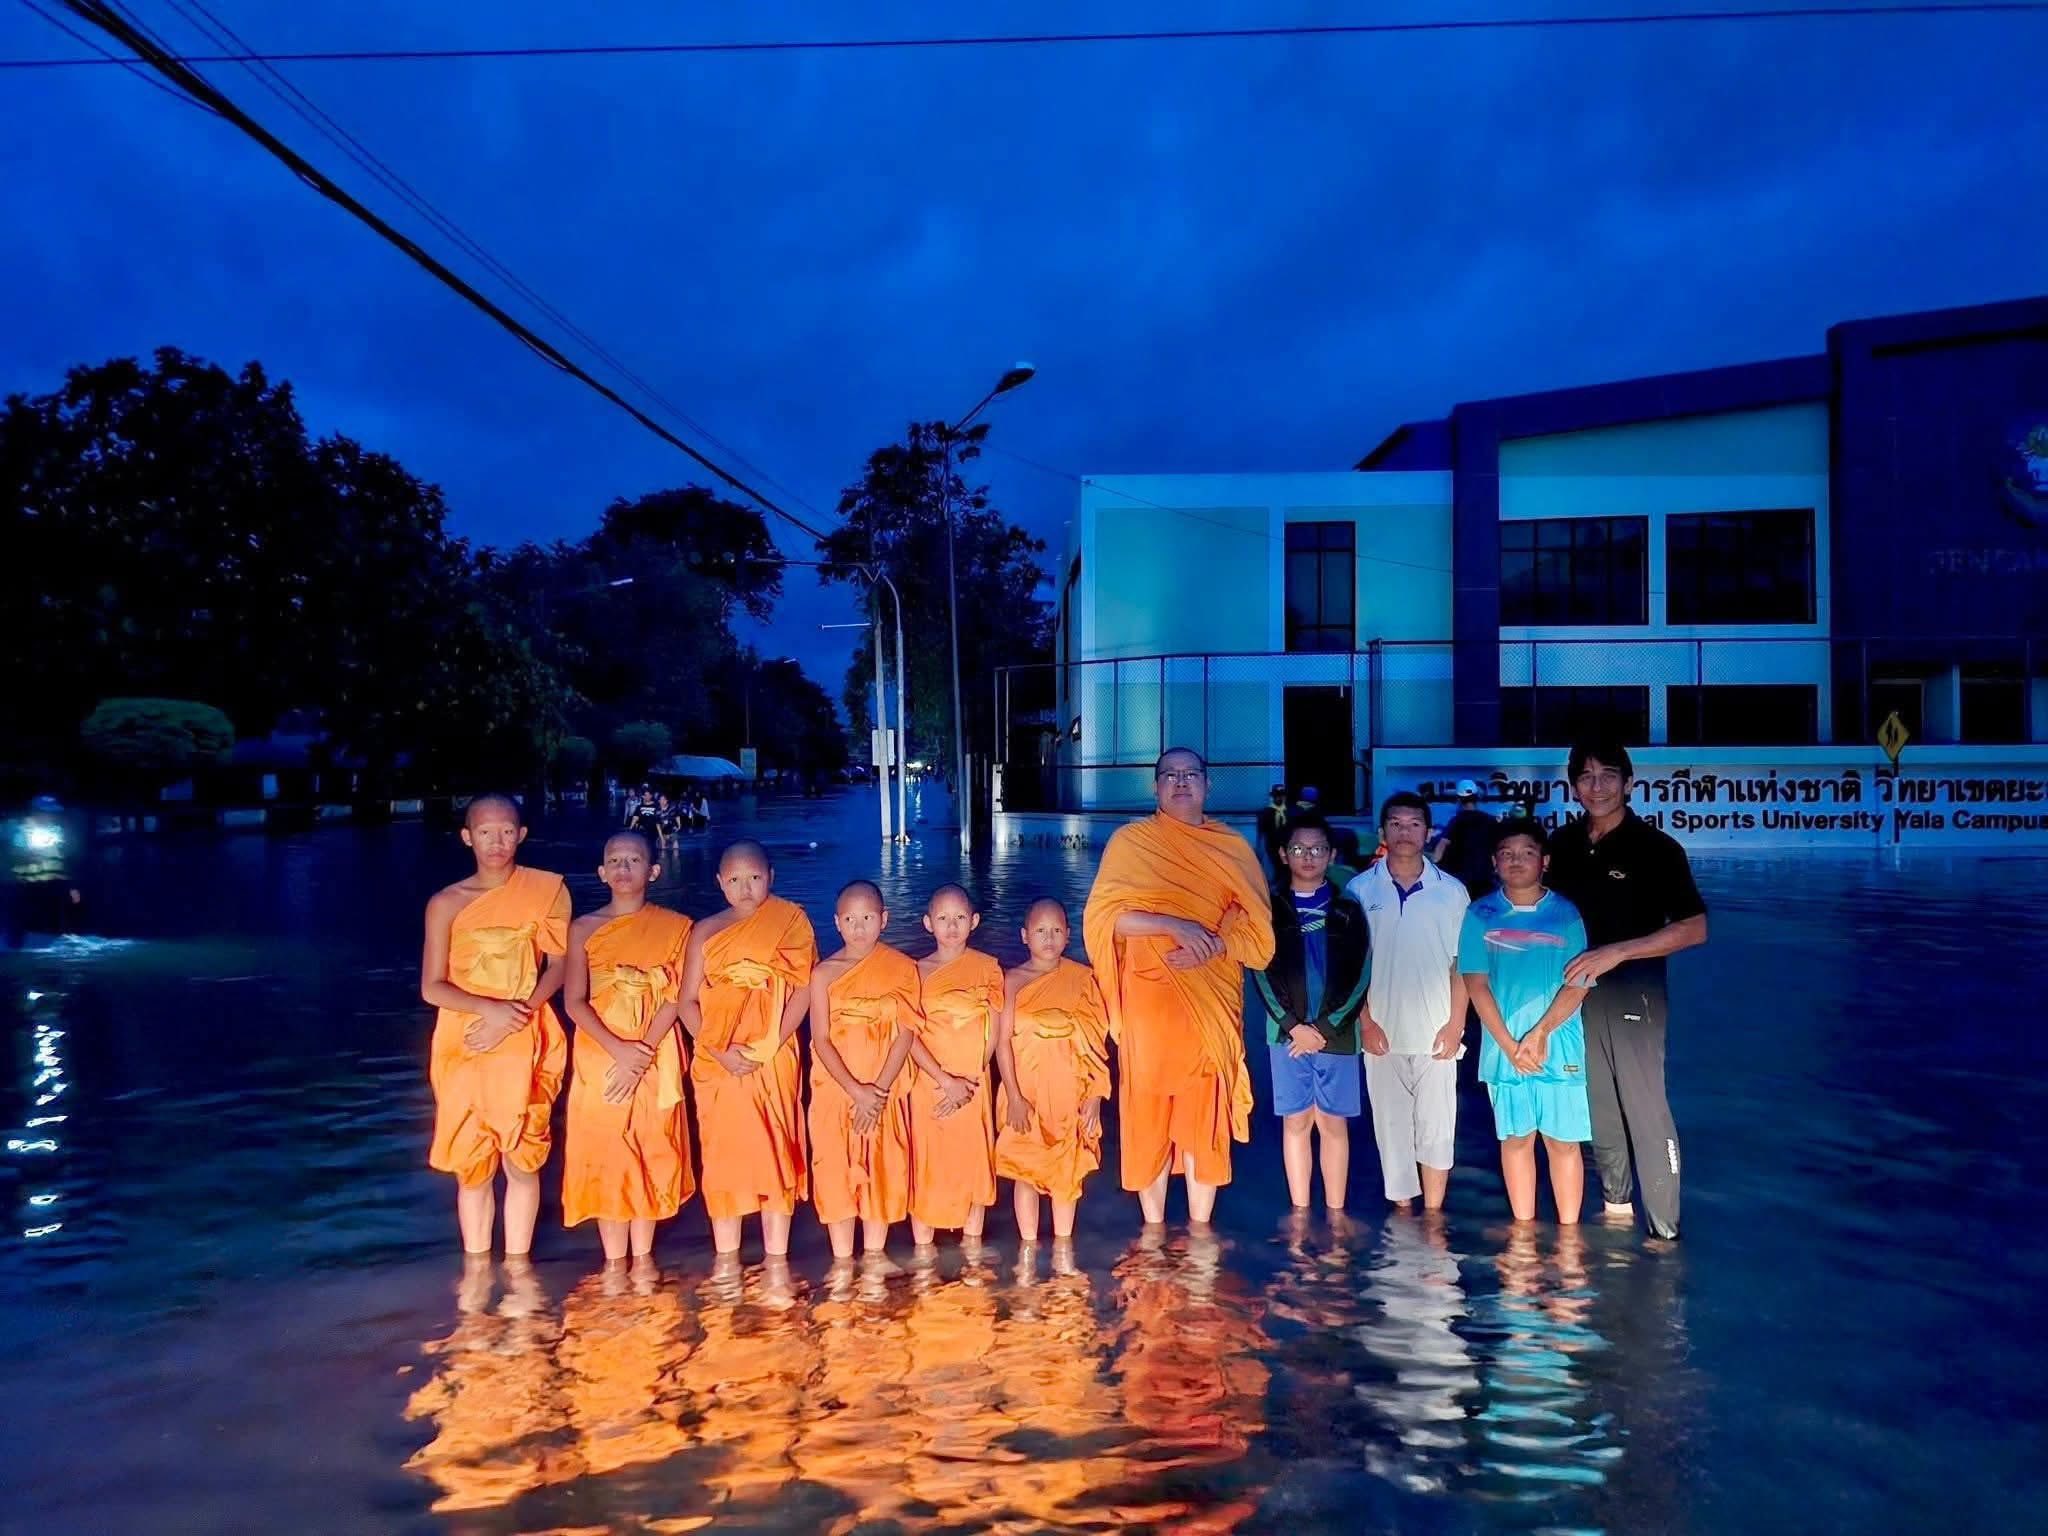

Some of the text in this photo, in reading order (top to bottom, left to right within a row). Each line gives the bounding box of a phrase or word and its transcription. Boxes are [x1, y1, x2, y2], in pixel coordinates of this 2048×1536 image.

[1671, 809, 1755, 833] Sports
[1762, 809, 1886, 833] University
[1896, 809, 1944, 830] Yala
